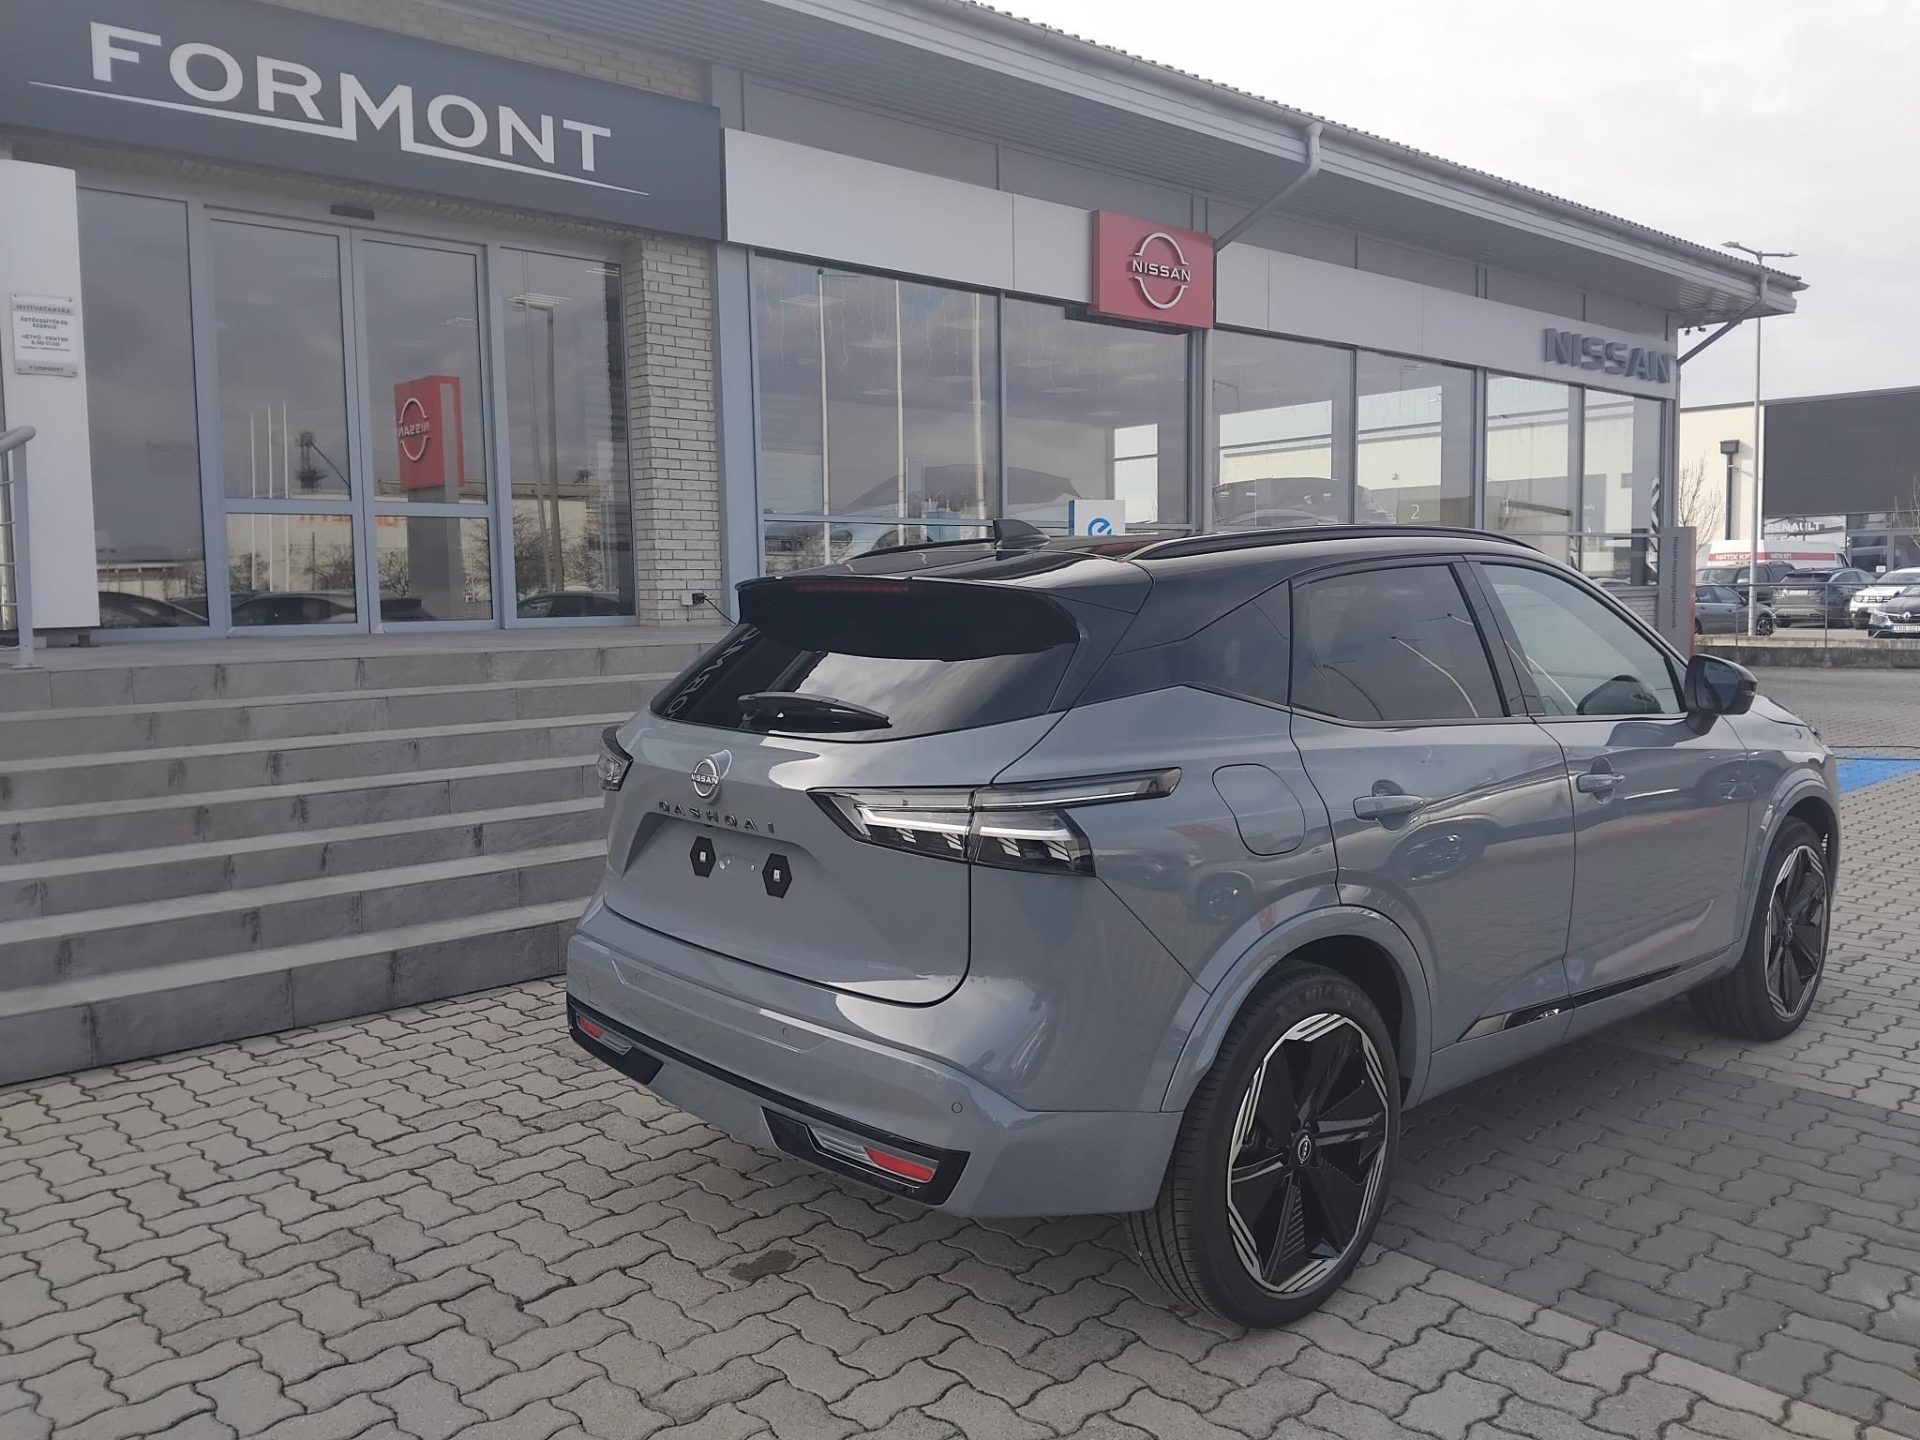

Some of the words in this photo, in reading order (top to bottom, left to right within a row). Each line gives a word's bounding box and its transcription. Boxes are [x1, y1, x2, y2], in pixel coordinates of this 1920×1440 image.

[90, 22, 612, 172] FORMONT
[1132, 259, 1191, 282] NISSAN
[1544, 328, 1671, 384] NISSAN
[1410, 504, 1421, 520] 2
[658, 800, 775, 834] QASHQAI
